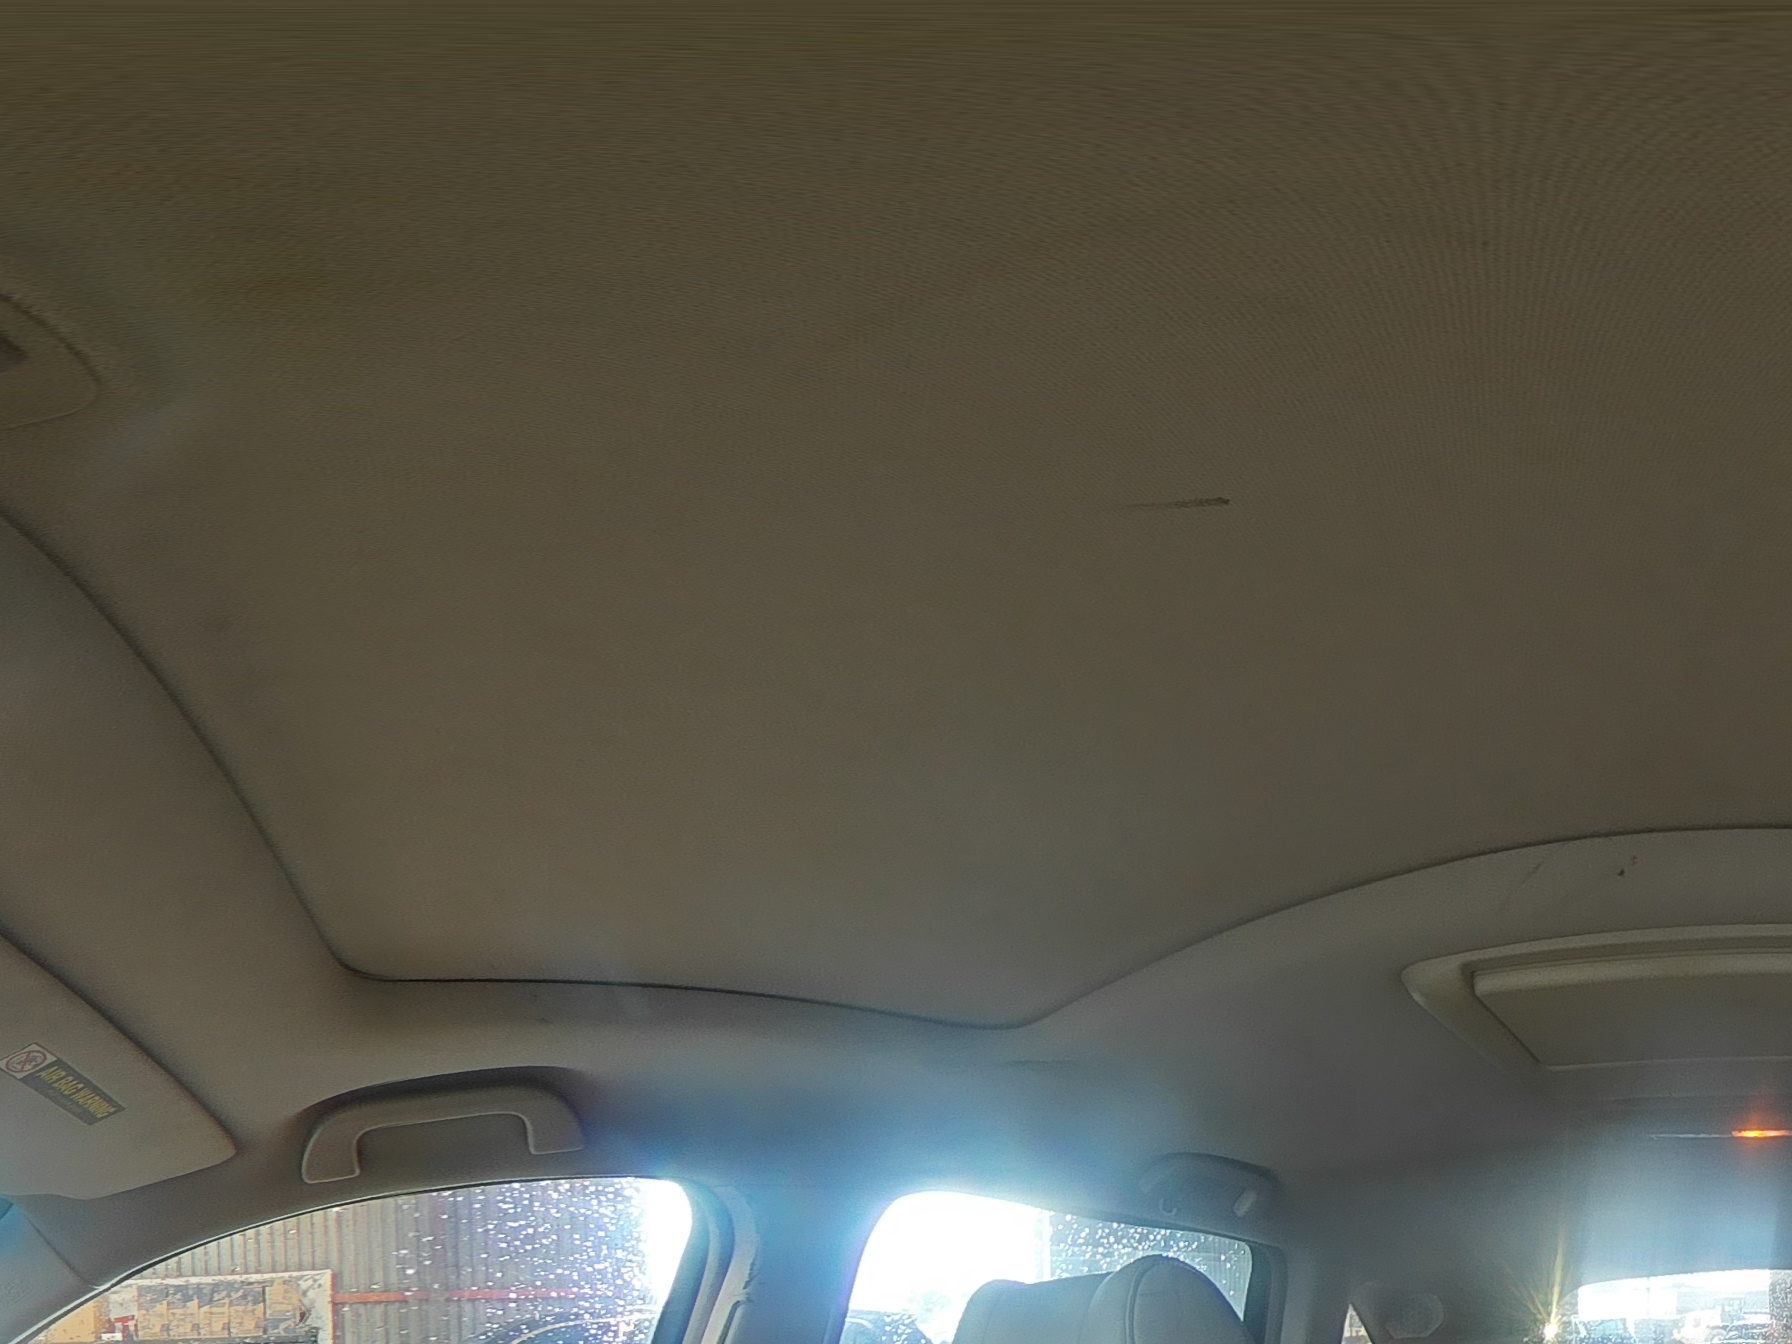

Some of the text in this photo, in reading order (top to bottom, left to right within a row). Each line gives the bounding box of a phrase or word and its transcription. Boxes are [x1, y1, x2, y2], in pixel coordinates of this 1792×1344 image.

[36, 1066, 67, 1084] AIR
[52, 1076, 85, 1096] BAG
[70, 1088, 117, 1118] WARNING
